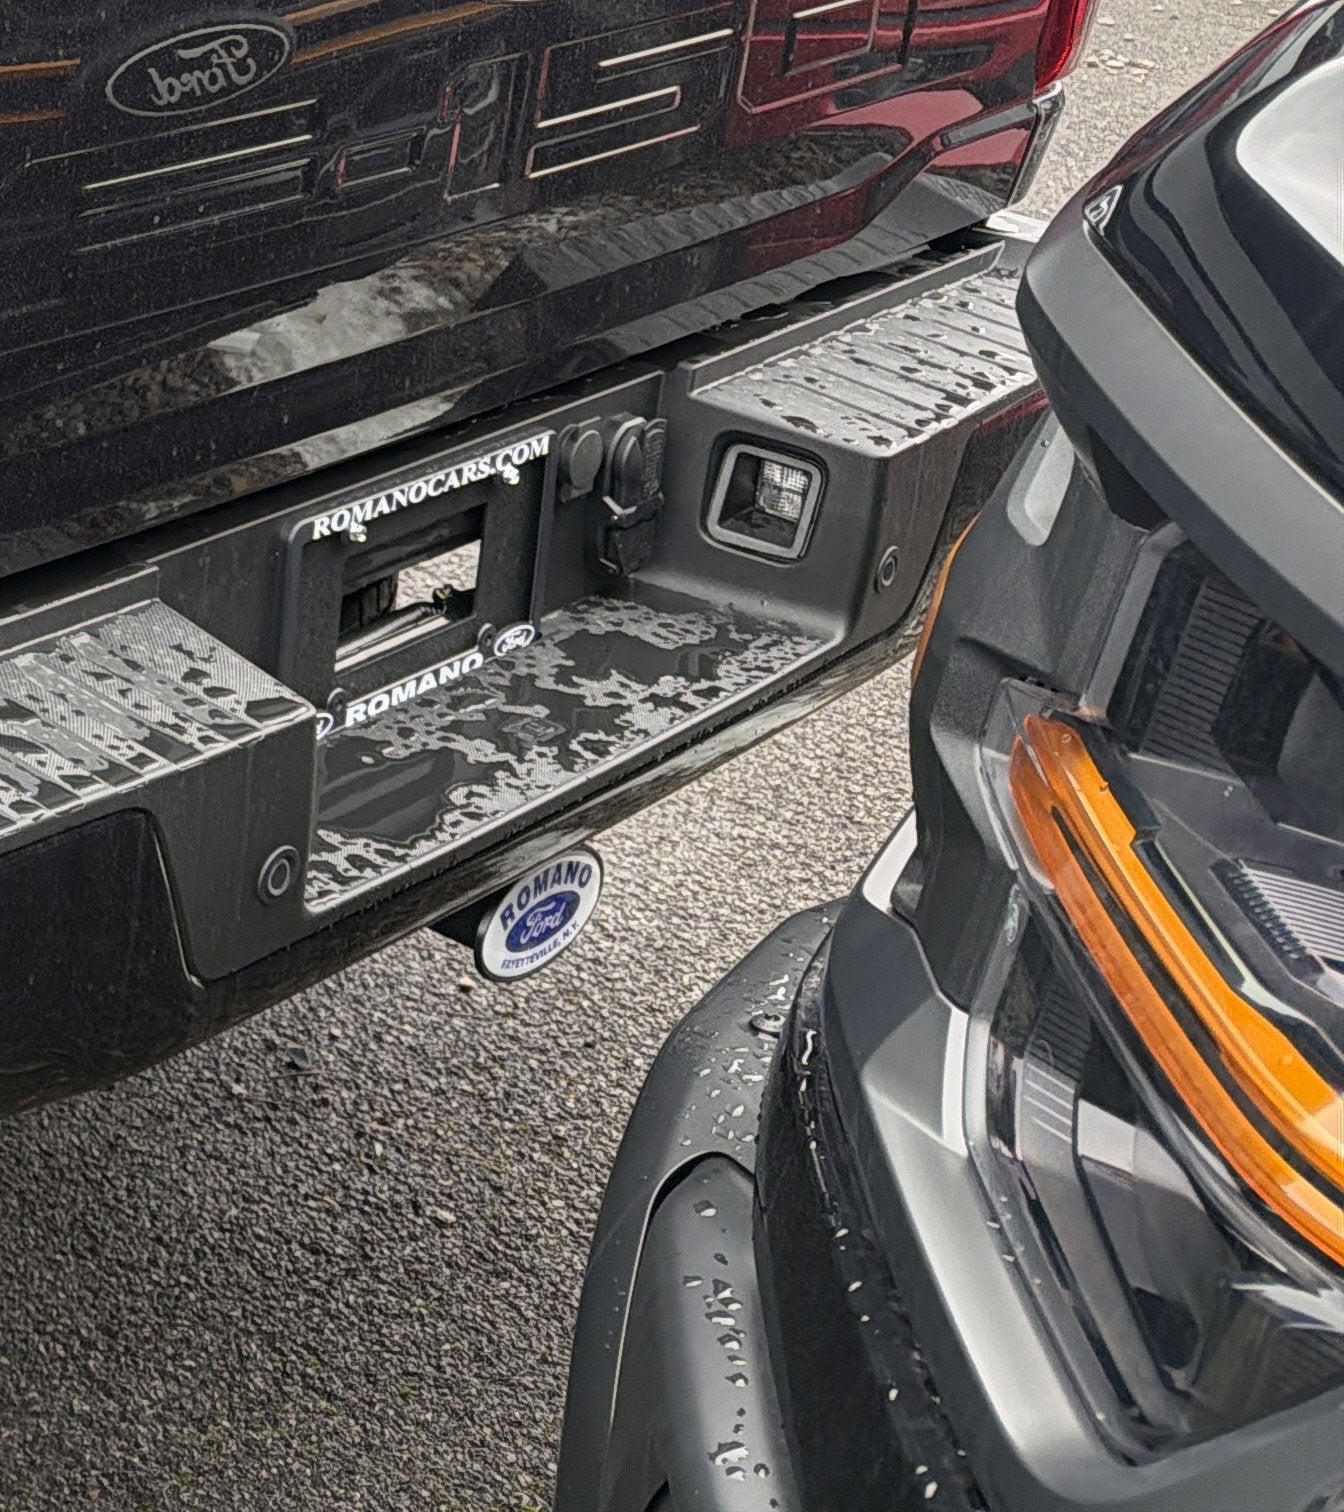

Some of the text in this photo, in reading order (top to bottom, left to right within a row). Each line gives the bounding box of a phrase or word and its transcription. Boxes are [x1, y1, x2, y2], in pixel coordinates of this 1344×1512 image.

[313, 435, 550, 541] ROMANOCARS.COM
[345, 652, 484, 727] ROMANO
[500, 861, 592, 932] ROMANO
[520, 901, 567, 944] Ford
